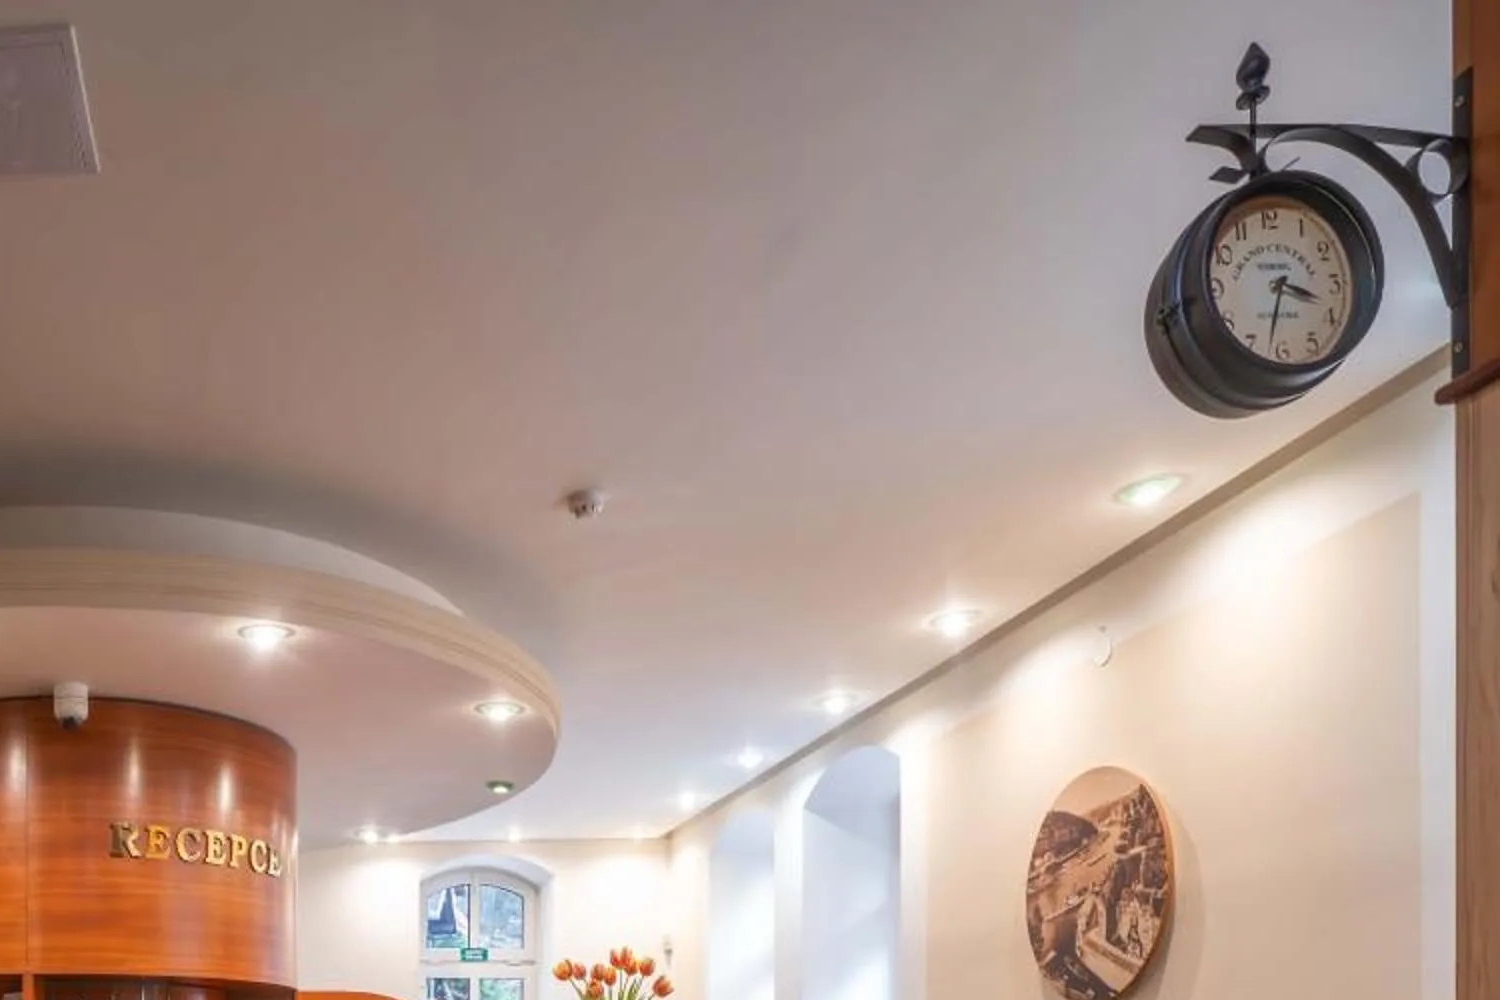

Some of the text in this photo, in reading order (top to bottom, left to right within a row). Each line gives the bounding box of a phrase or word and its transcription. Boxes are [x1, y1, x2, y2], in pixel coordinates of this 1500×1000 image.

[1235, 221, 1247, 241] 11
[1261, 211, 1279, 231] 12
[1298, 218, 1304, 238] 1
[1215, 243, 1233, 266] 10
[1317, 241, 1331, 262] 2
[1328, 273, 1341, 296] 3
[1275, 341, 1291, 361] 6
[1306, 331, 1319, 357] 5
[109, 820, 282, 878] RECEPCE
